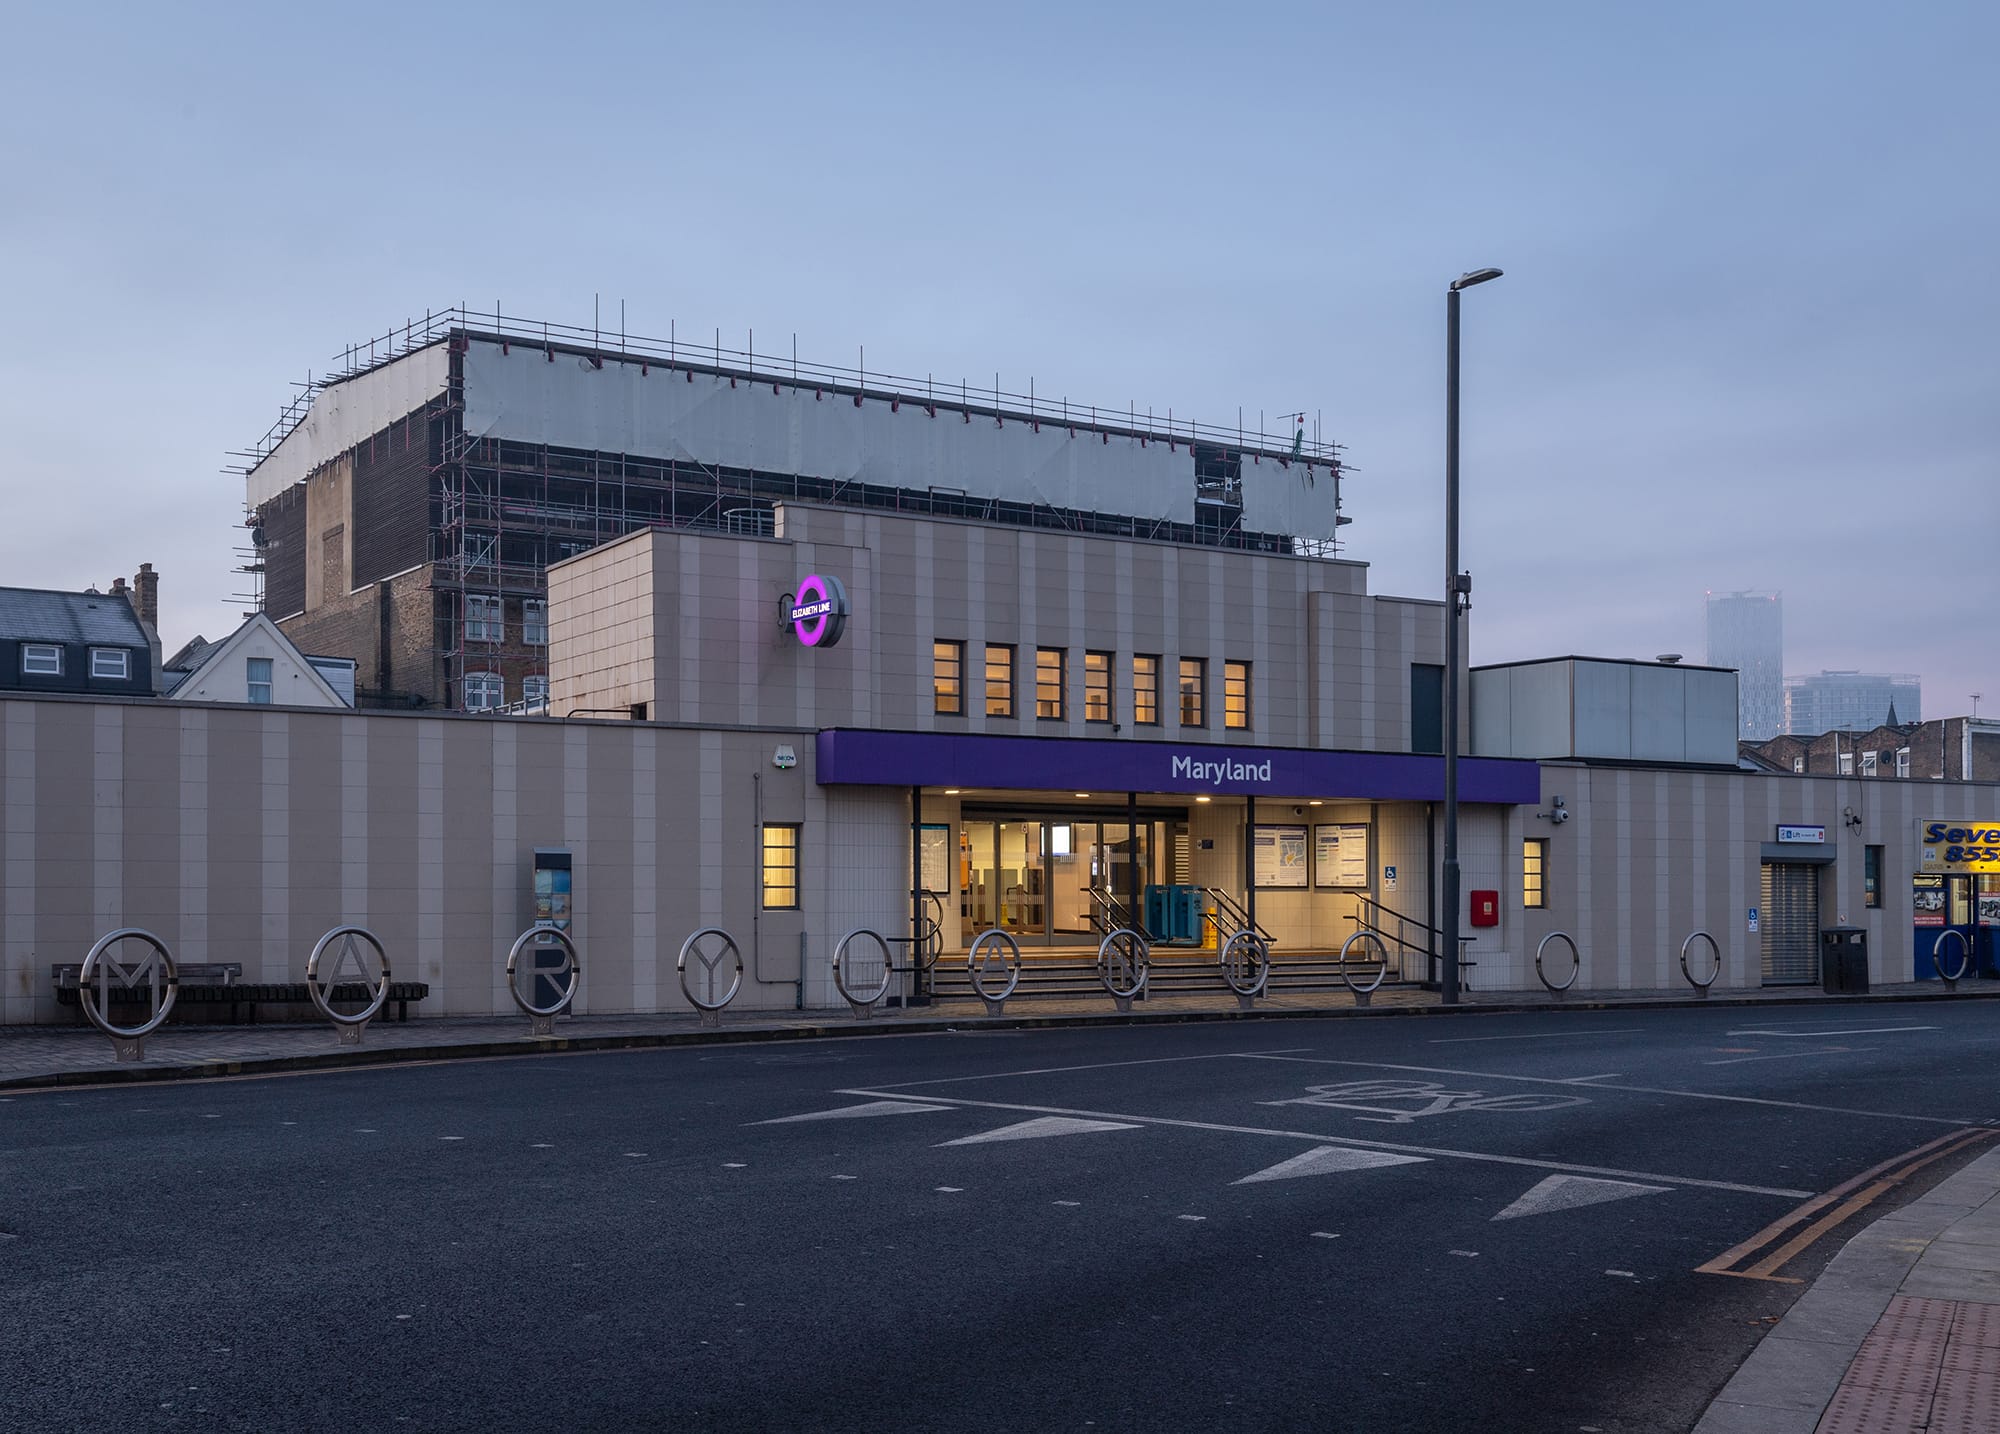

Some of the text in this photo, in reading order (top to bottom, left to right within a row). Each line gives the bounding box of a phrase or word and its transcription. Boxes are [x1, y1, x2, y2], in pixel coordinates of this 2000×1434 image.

[792, 601, 831, 619] ELIZABETH LINE
[1172, 755, 1271, 785] Maryland
[1923, 823, 2000, 844] Seve
[1943, 845, 2000, 862] 855
